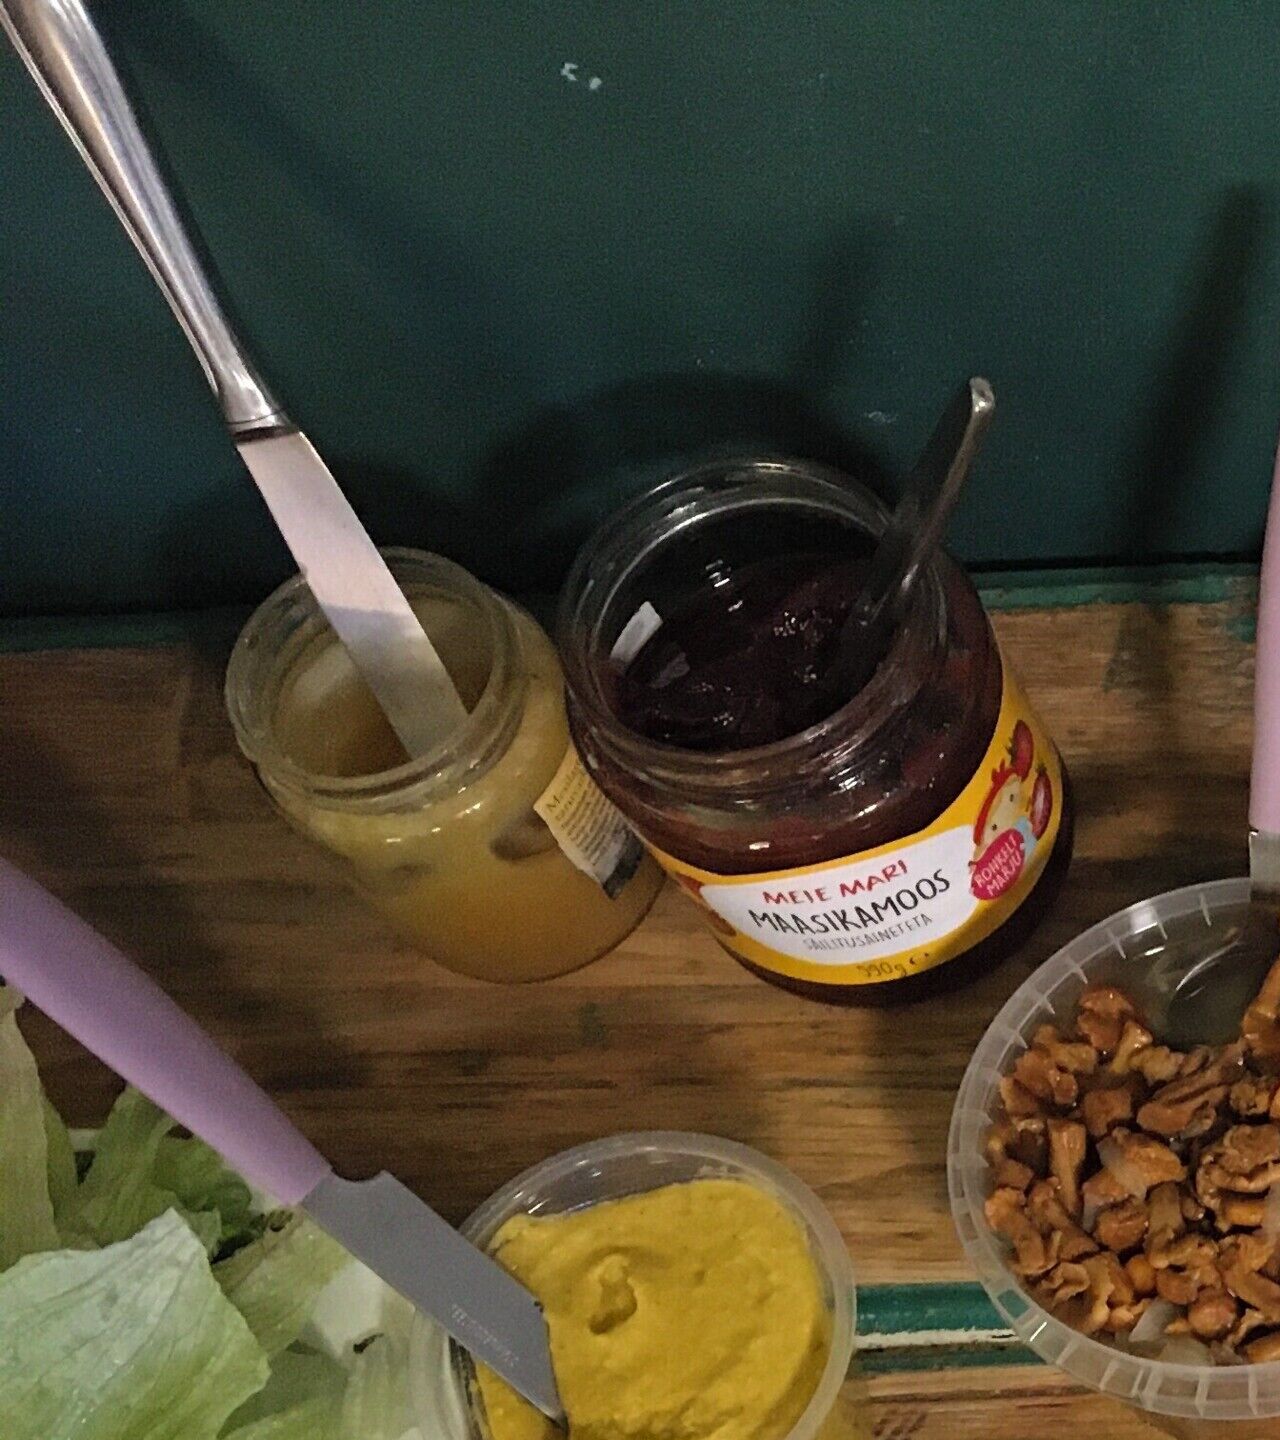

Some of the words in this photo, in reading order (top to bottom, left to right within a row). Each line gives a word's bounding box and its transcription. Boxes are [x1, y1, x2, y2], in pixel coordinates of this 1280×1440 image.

[748, 868, 951, 935] MAASIKAMOOS
[762, 887, 832, 905] MEIE
[838, 859, 909, 898] MARI
